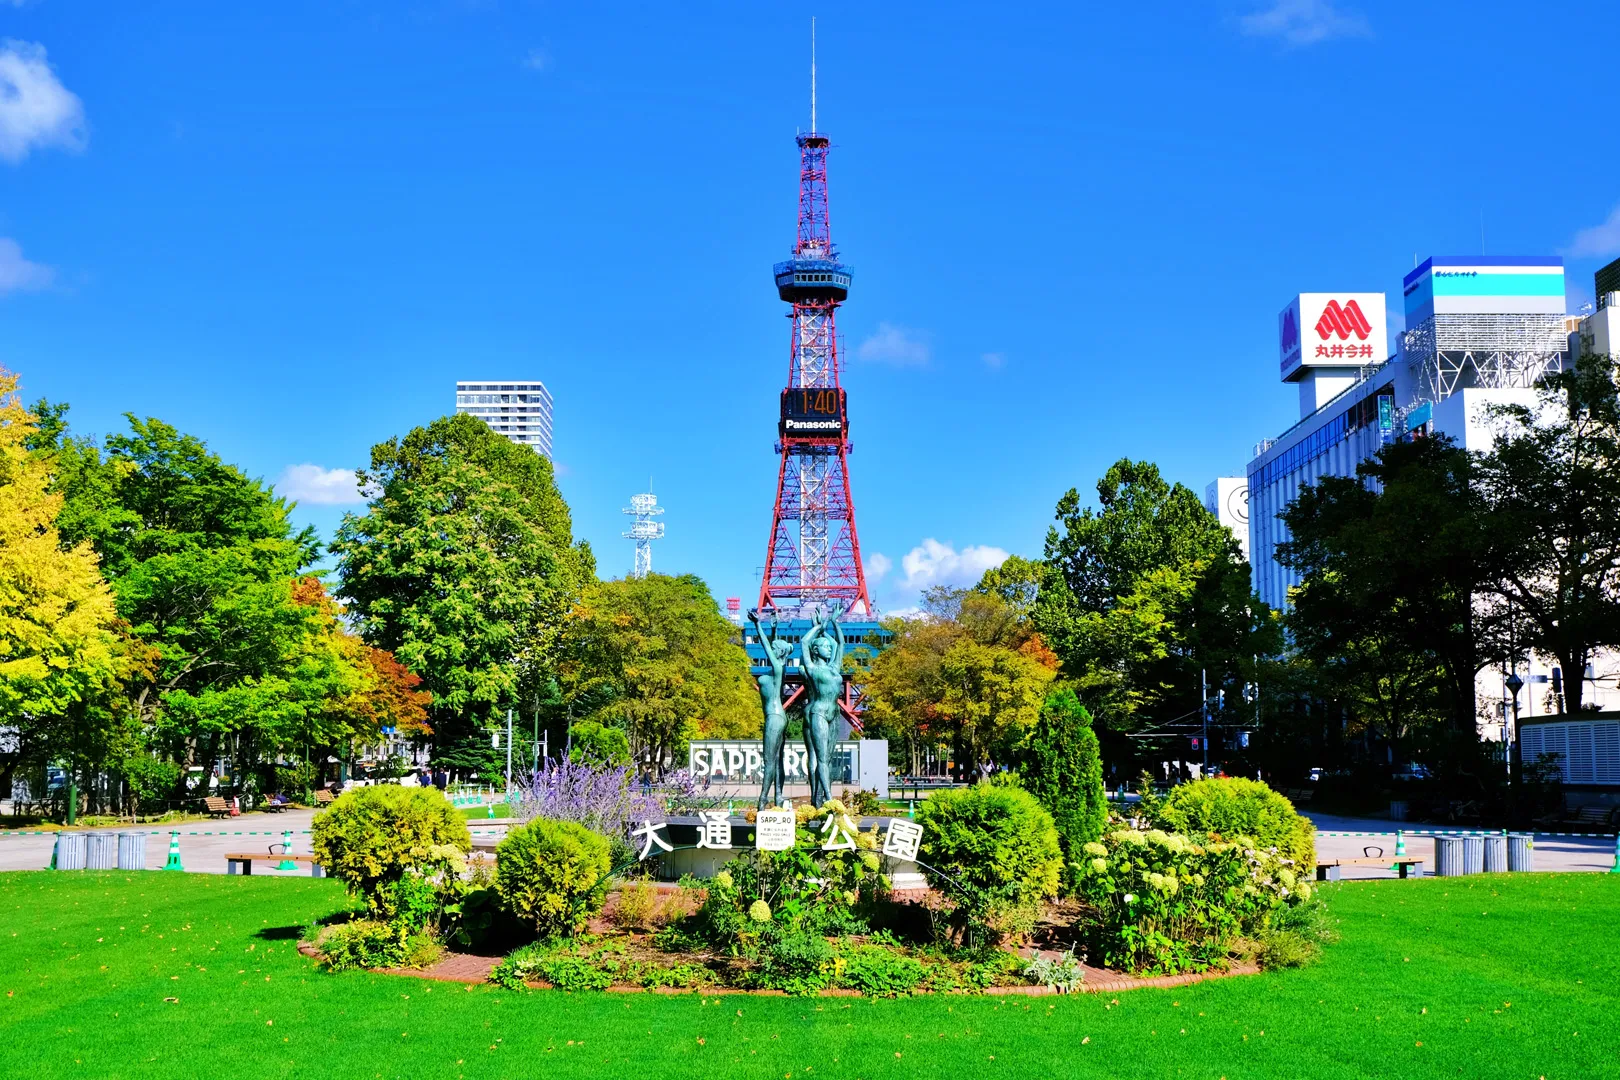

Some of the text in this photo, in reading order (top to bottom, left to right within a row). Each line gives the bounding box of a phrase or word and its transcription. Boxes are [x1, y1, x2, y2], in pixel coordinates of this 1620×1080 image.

[1315, 344, 1373, 358] 丸井今井
[803, 390, 837, 414] 1:40
[785, 419, 842, 429] Panasonic
[694, 749, 810, 778] SAPPR
